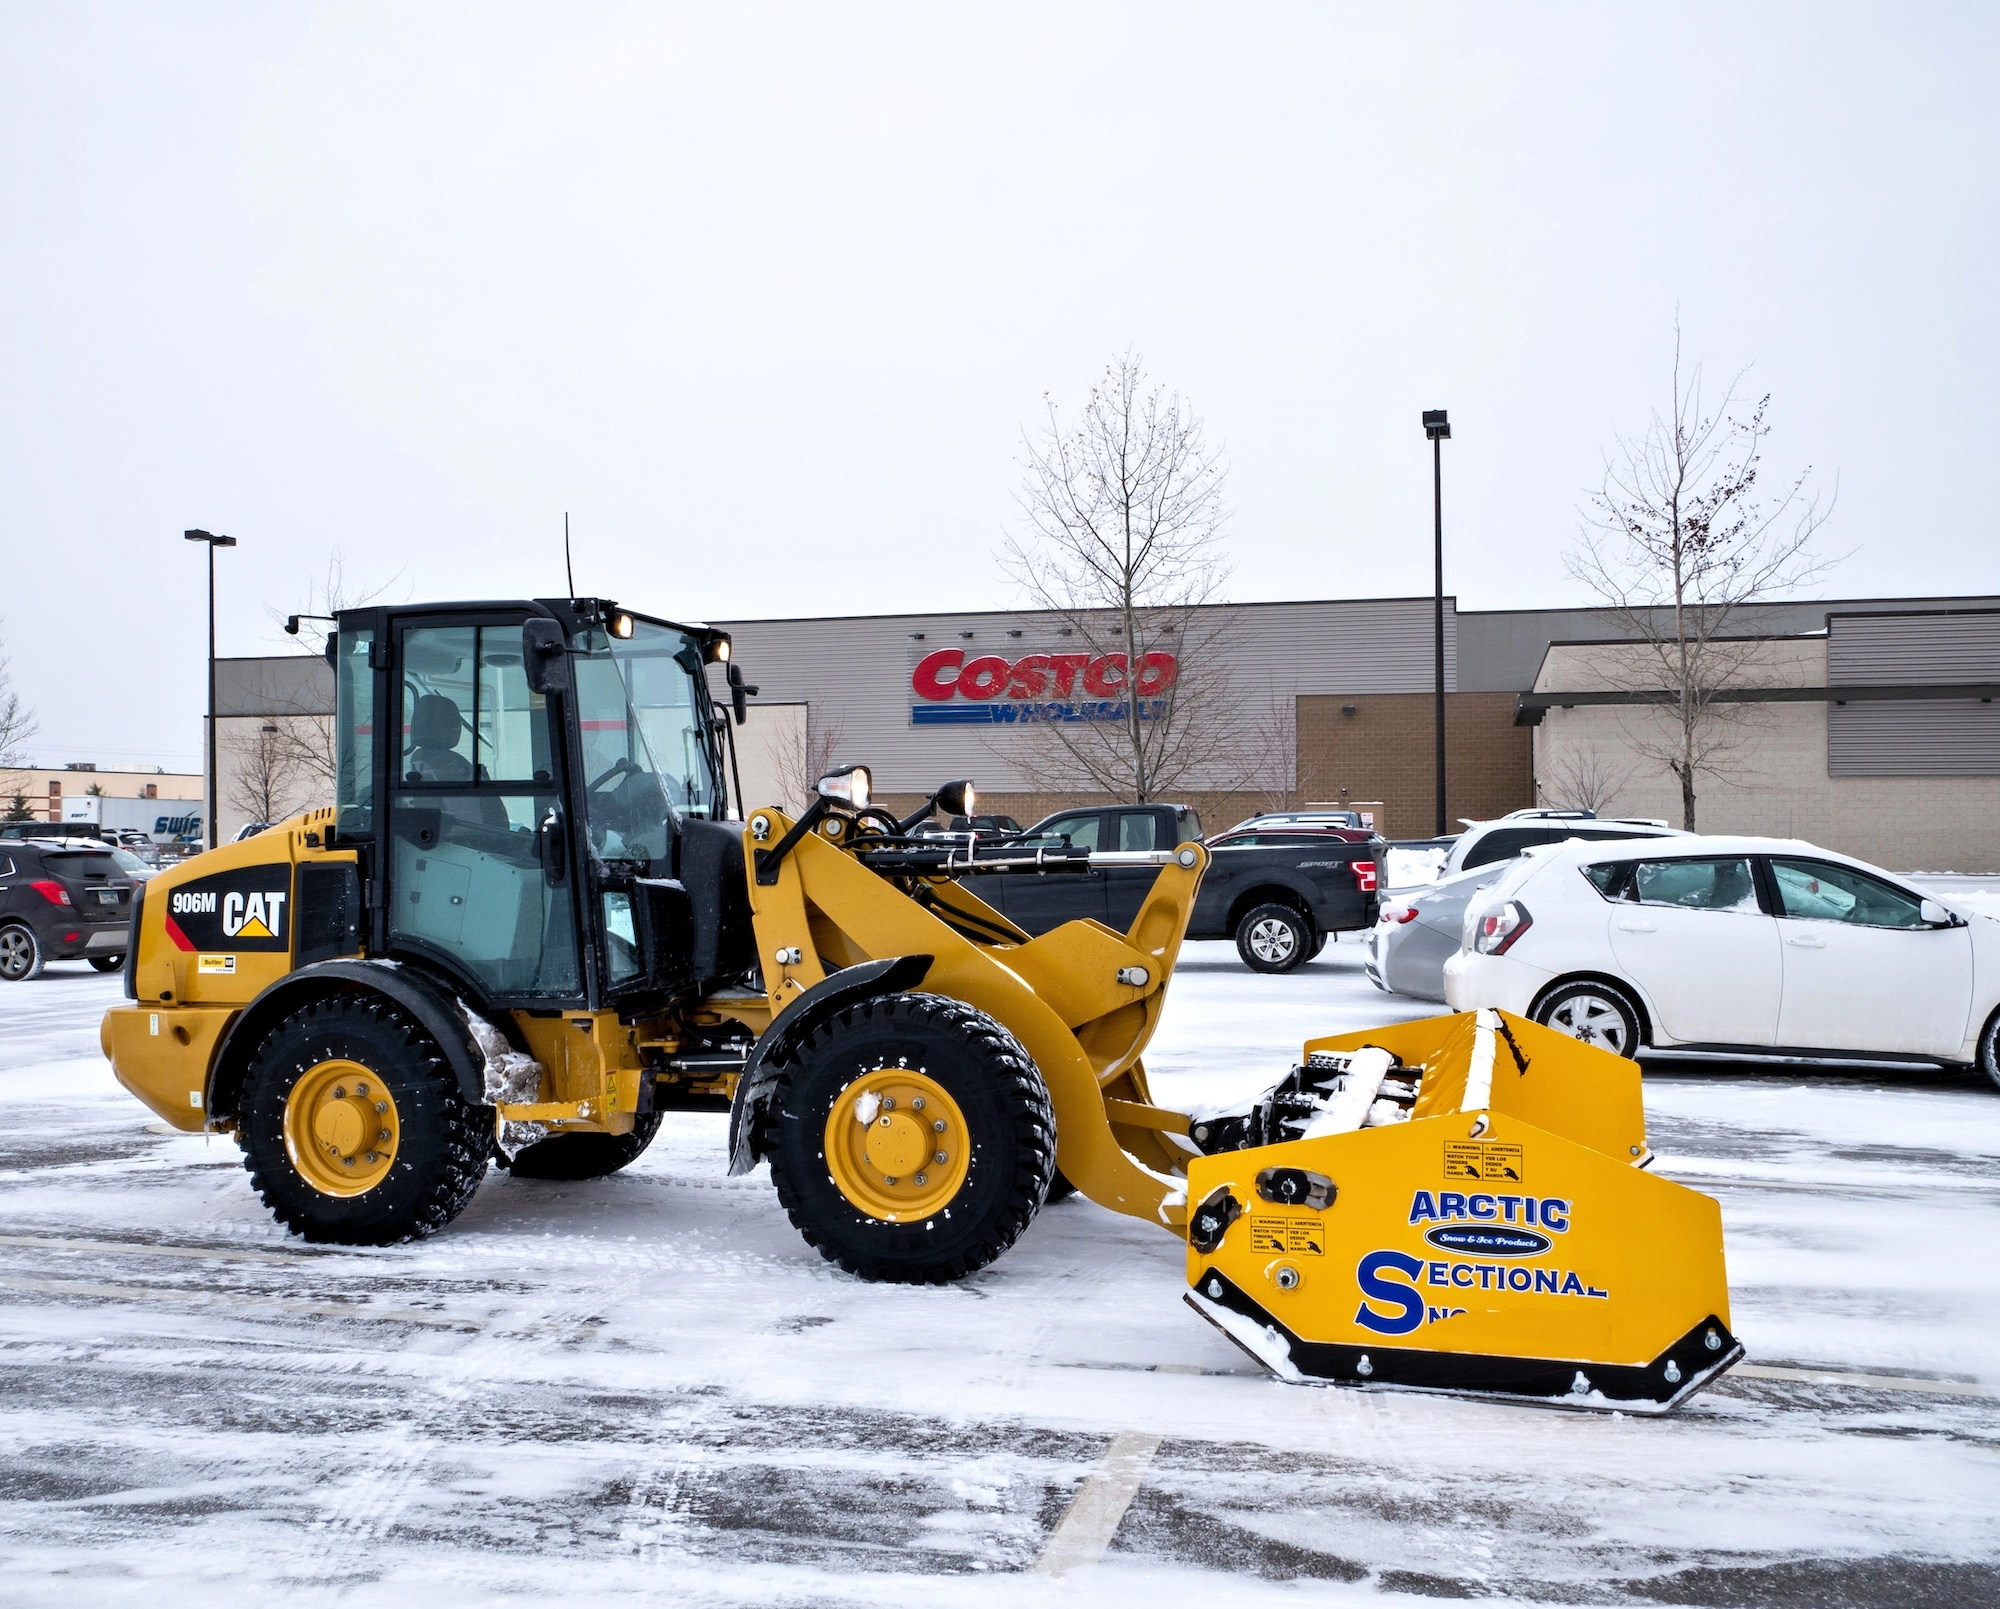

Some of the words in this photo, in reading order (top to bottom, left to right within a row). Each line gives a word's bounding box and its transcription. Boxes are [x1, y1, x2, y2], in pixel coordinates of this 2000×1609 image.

[912, 647, 1177, 701] COSTCO
[1295, 860, 1344, 868] SPORT
[173, 892, 216, 913] 906M
[223, 891, 286, 937] CAT
[1408, 1190, 1570, 1233] ARCTIC
[1440, 1234, 1466, 1243] Snow
[1467, 1235, 1475, 1243] &
[1476, 1236, 1493, 1245] Ice
[1495, 1237, 1538, 1248] Products
